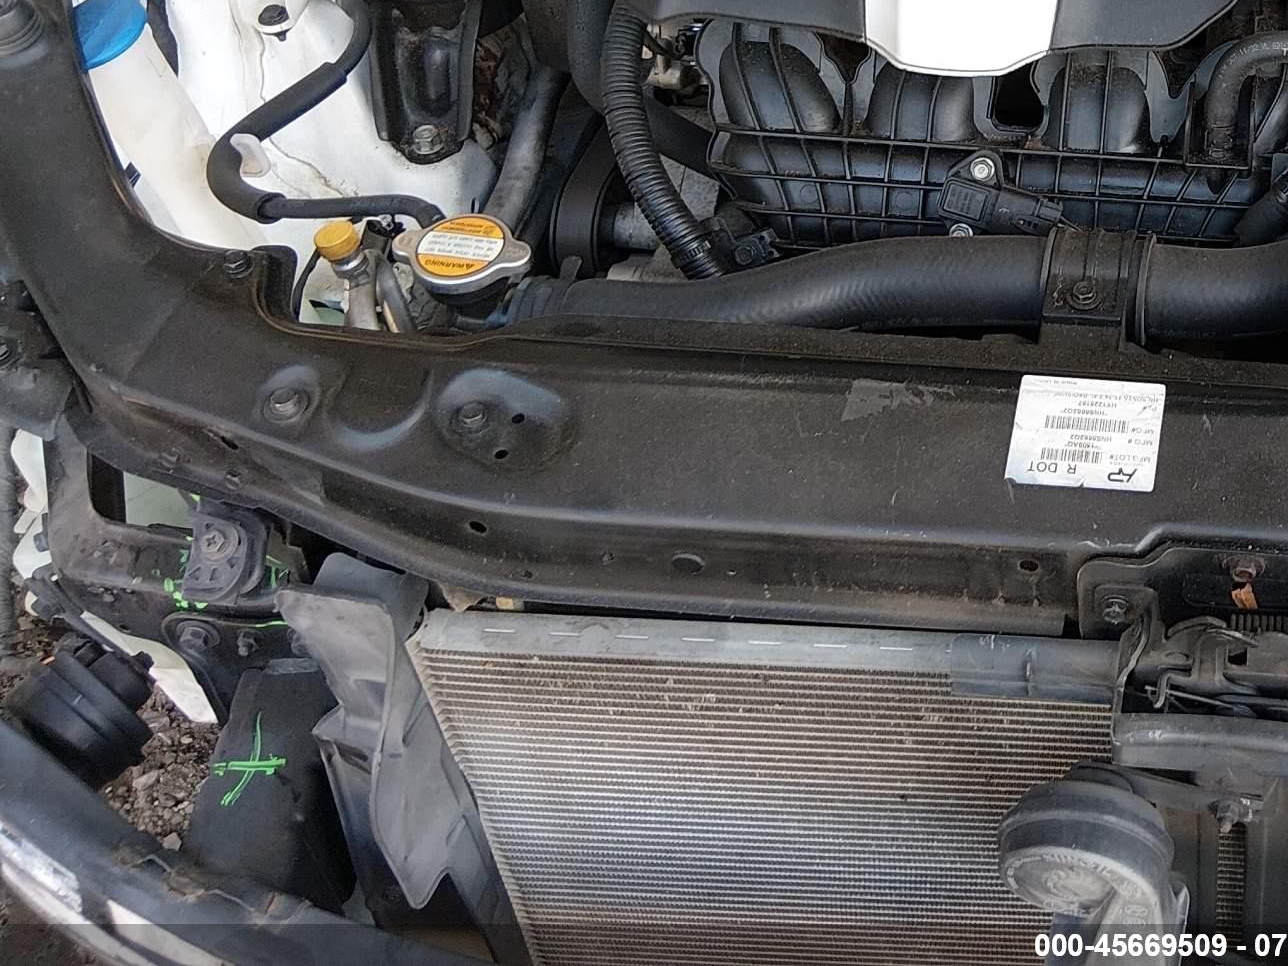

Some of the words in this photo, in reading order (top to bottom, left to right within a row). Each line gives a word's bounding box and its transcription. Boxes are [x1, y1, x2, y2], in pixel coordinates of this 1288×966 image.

[424, 259, 467, 270] WARNING
[1027, 460, 1058, 474] DOT
[1067, 463, 1077, 475] R
